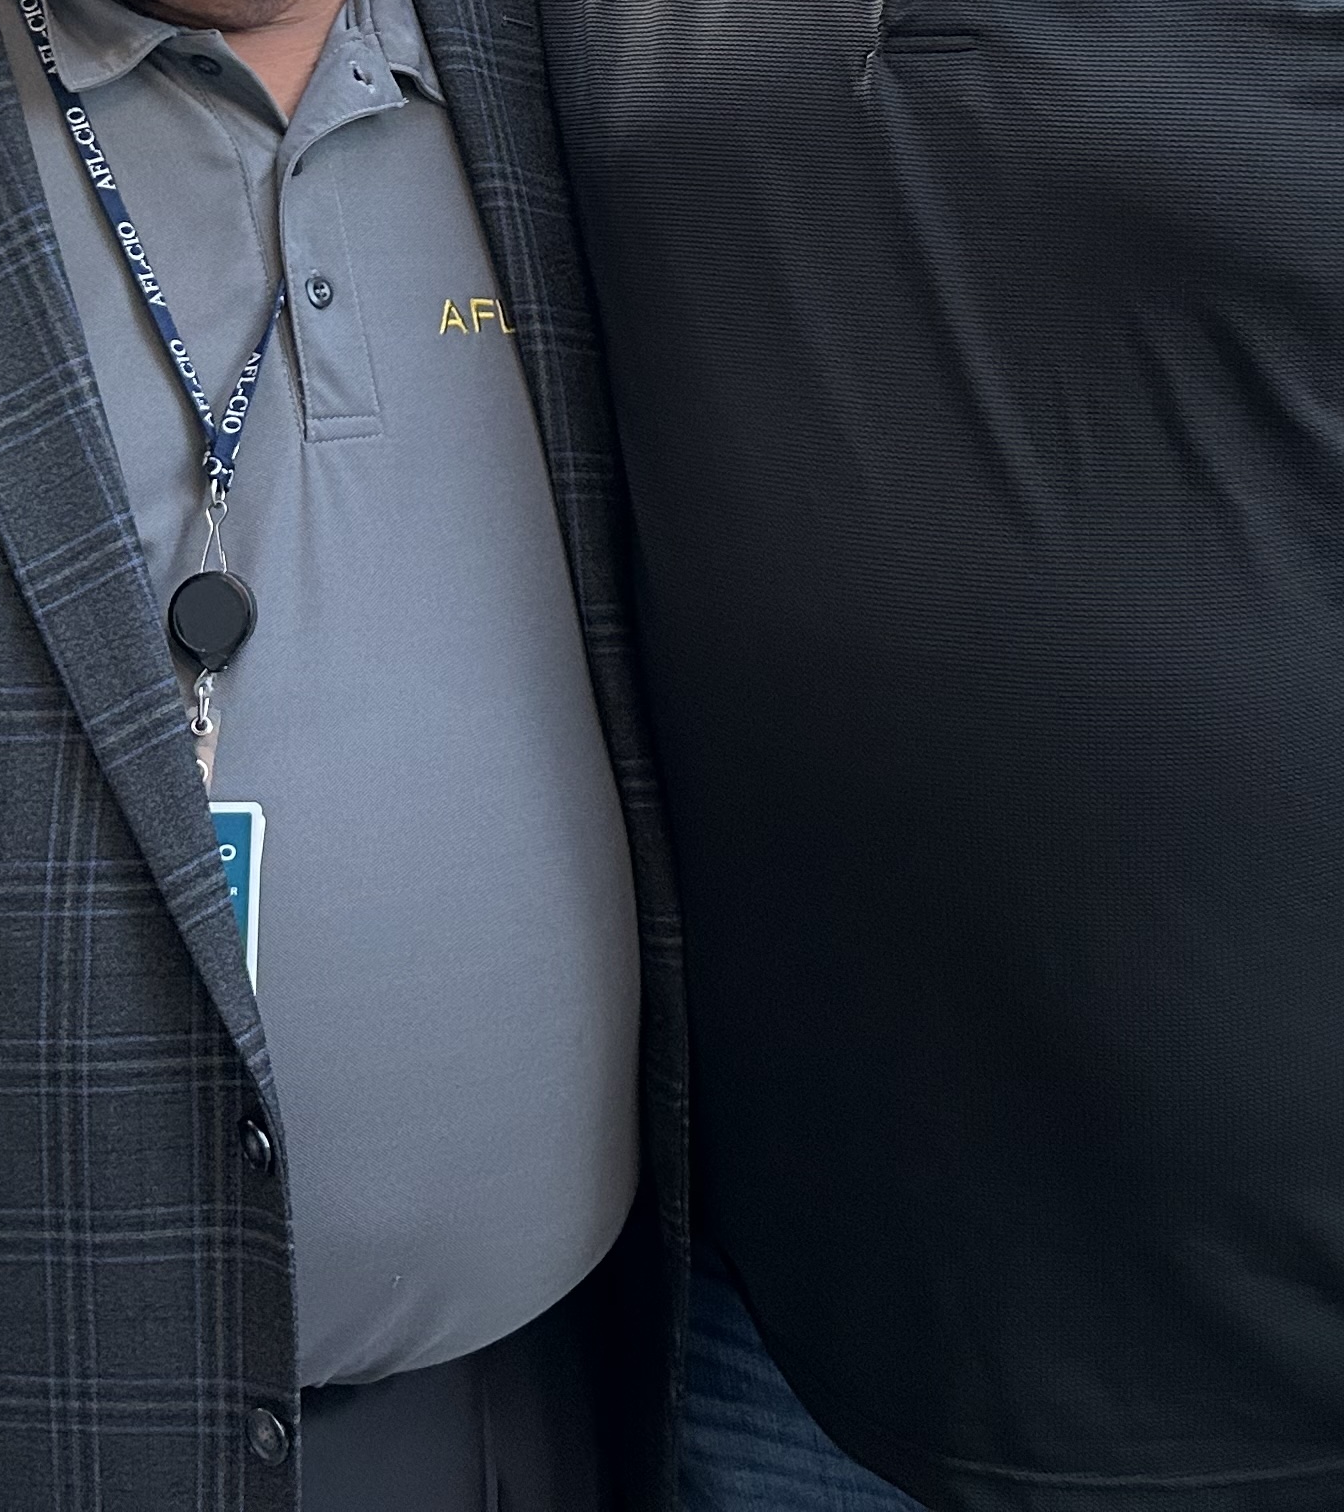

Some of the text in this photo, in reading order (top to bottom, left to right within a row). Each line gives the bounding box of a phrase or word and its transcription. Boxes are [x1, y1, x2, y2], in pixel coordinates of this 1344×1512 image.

[65, 106, 117, 190] AFL-CIO
[117, 221, 167, 307] AFL-CIO
[439, 298, 516, 335] AFL
[169, 338, 215, 428] AFL-CIO
[222, 352, 262, 434] AFL-CIO
